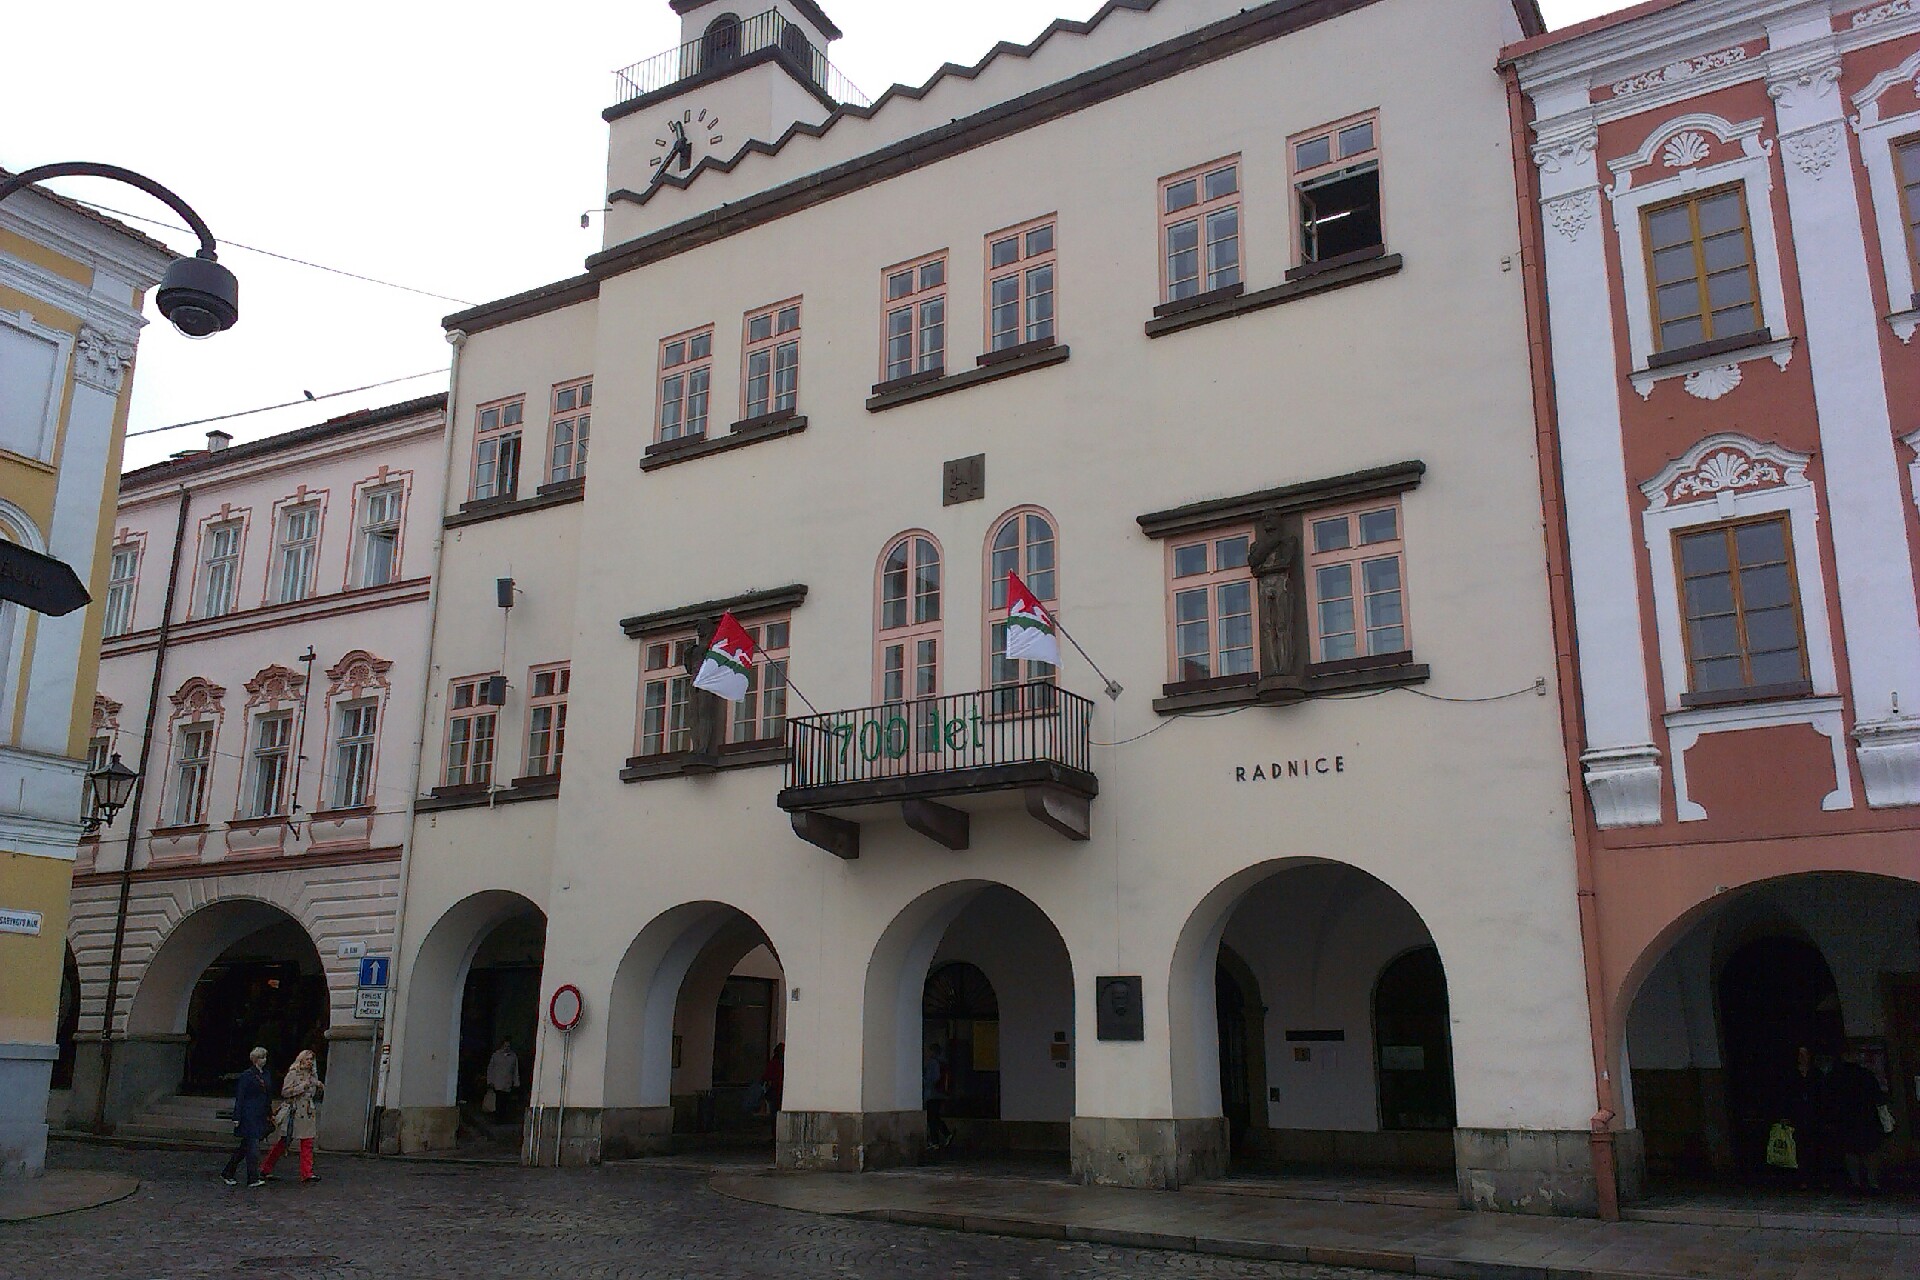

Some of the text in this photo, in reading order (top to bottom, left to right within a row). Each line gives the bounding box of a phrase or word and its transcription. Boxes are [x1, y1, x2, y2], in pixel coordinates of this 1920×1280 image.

[833, 704, 984, 764] 700 let
[1235, 755, 1344, 782] RADNICE
